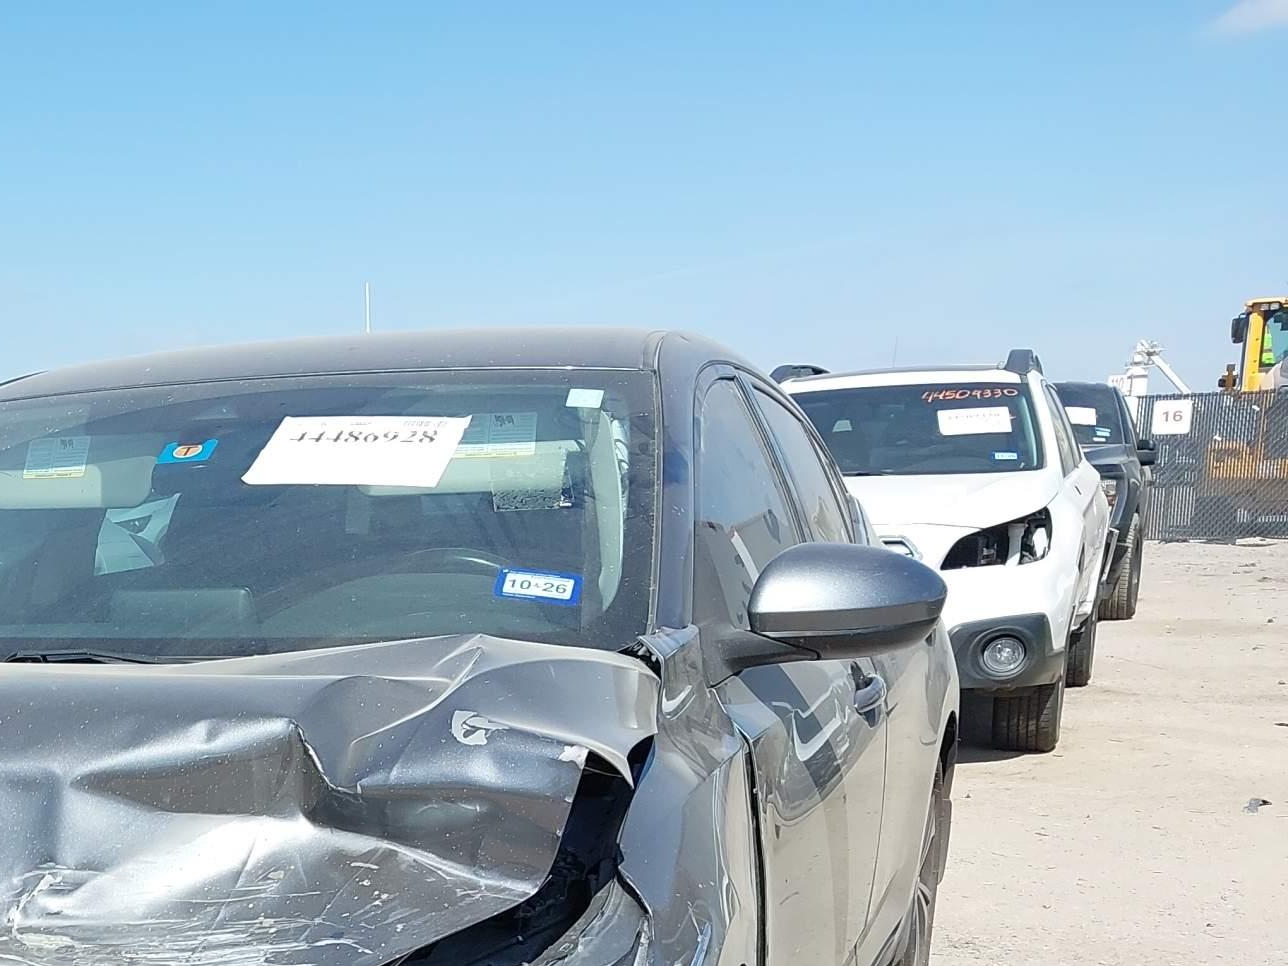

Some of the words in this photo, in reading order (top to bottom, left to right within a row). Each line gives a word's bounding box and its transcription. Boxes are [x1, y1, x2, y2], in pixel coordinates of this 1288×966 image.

[921, 388, 1018, 403] 44509330
[1162, 410, 1184, 423] 16
[289, 429, 439, 444] 44486928
